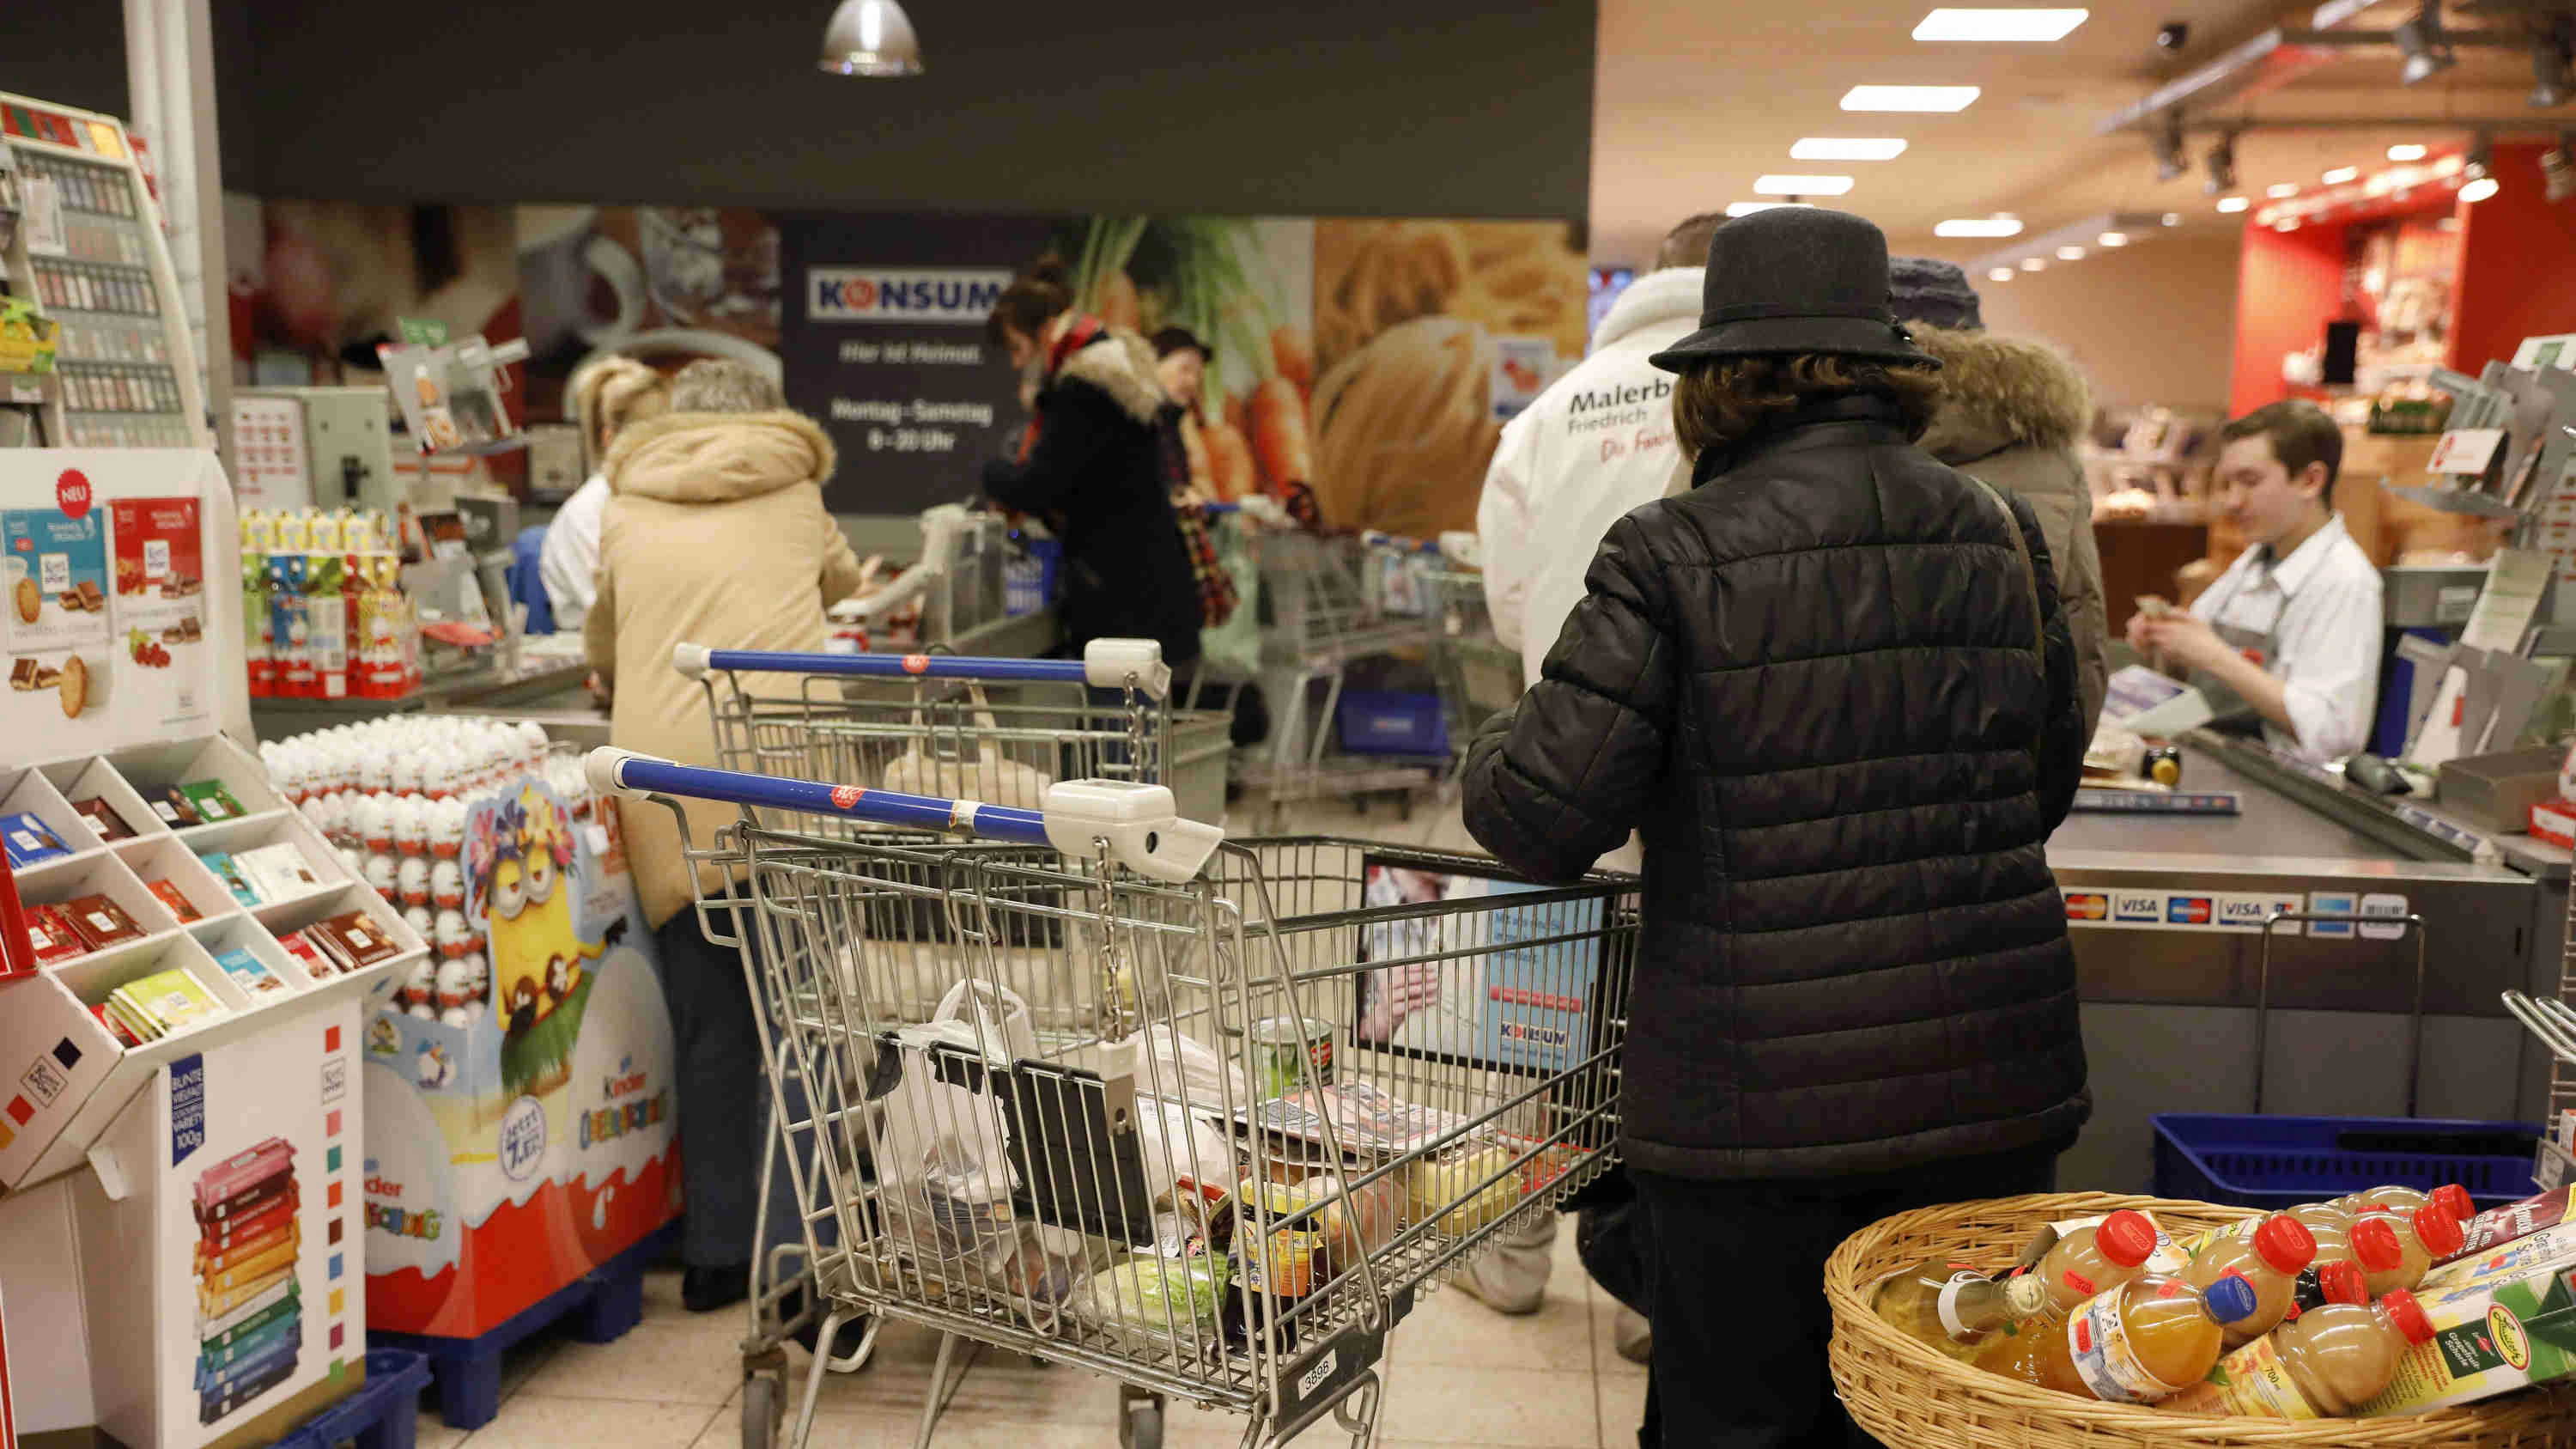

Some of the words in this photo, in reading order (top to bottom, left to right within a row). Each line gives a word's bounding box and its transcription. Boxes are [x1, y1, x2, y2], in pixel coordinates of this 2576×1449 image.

[820, 279, 1000, 310] KONSUM
[1569, 377, 1670, 414] Malerb
[61, 485, 87, 502] NEU
[2123, 900, 2158, 914] VISA
[2227, 903, 2262, 916] VISA
